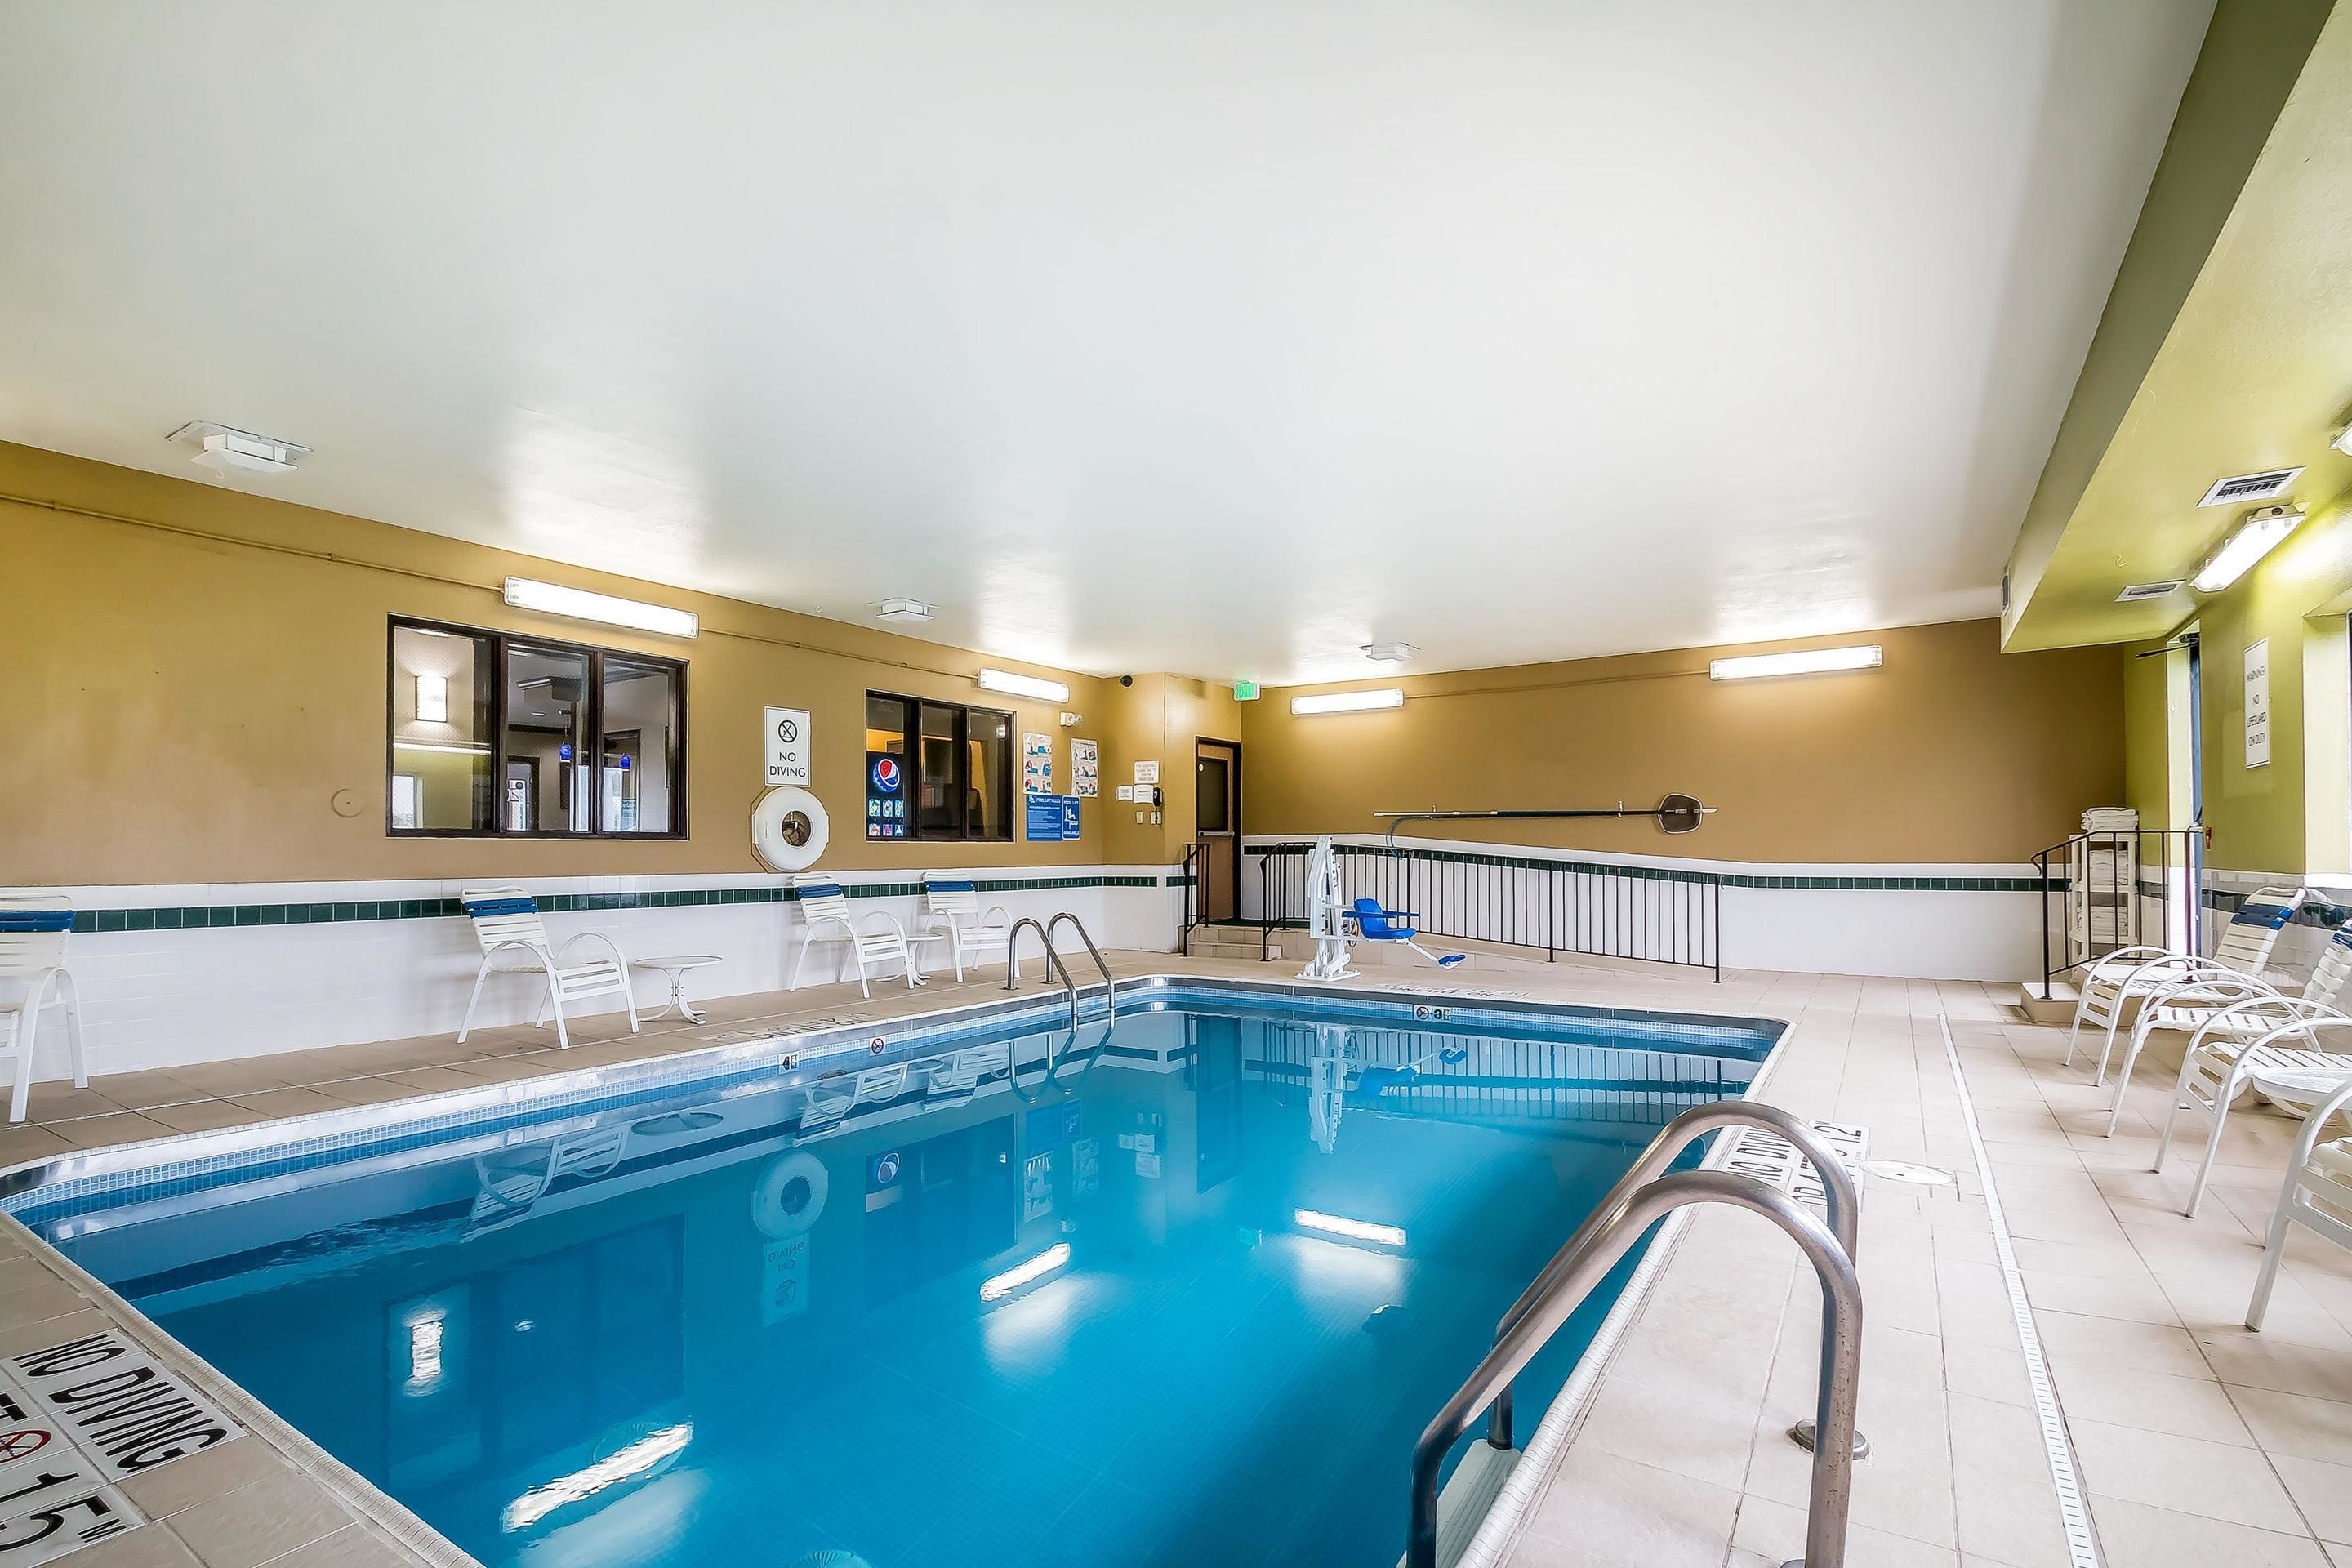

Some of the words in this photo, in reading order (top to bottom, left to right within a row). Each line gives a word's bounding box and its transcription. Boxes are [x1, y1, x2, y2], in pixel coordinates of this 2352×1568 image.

[769, 765, 806, 777] DIVING
[779, 751, 796, 762] NO
[1735, 1128, 1792, 1160] DIVIN
[12, 1334, 127, 1378] NO
[48, 1366, 228, 1473] DIVING
